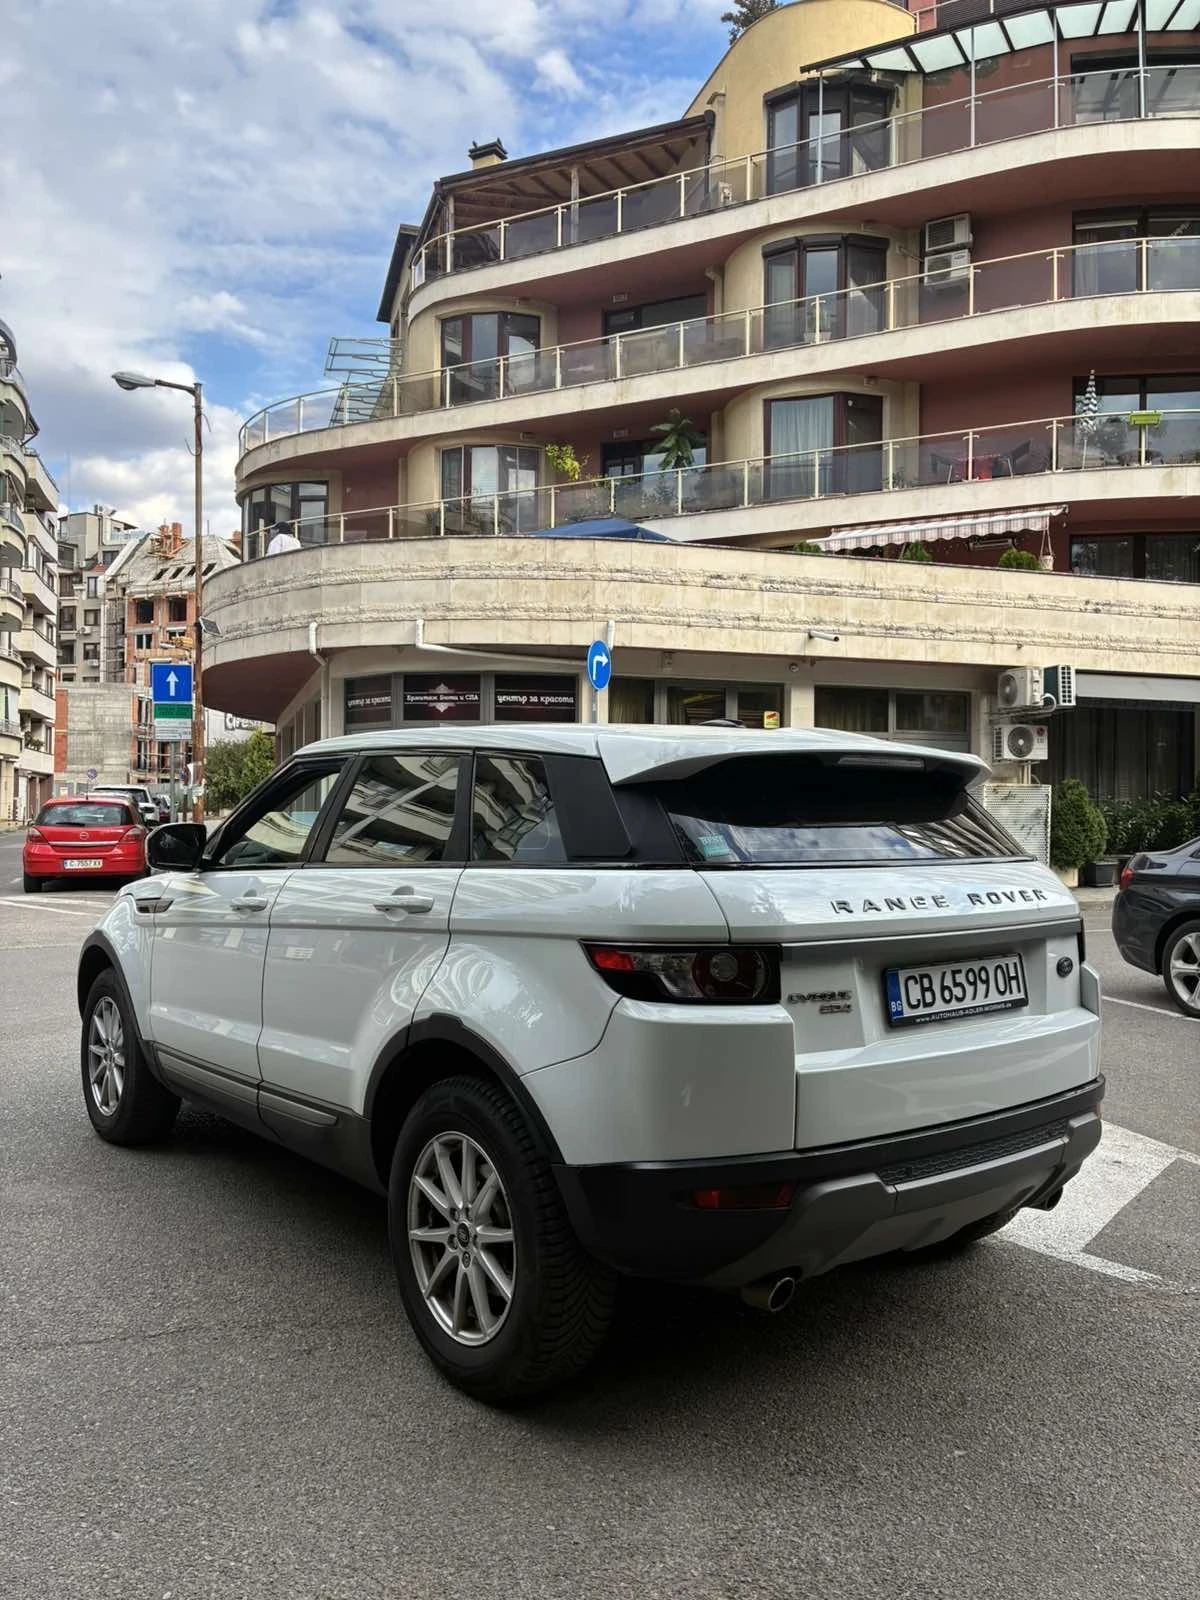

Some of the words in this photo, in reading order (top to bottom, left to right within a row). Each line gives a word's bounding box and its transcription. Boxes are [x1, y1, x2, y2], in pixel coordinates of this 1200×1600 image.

[497, 695, 528, 704] център
[540, 695, 574, 705] красота
[830, 894, 950, 914] RANGE
[966, 888, 1048, 906] ROVER
[904, 973, 937, 1010] CB
[940, 965, 991, 1005] 6599
[994, 962, 1022, 996] OH
[890, 1000, 903, 1012] BG
